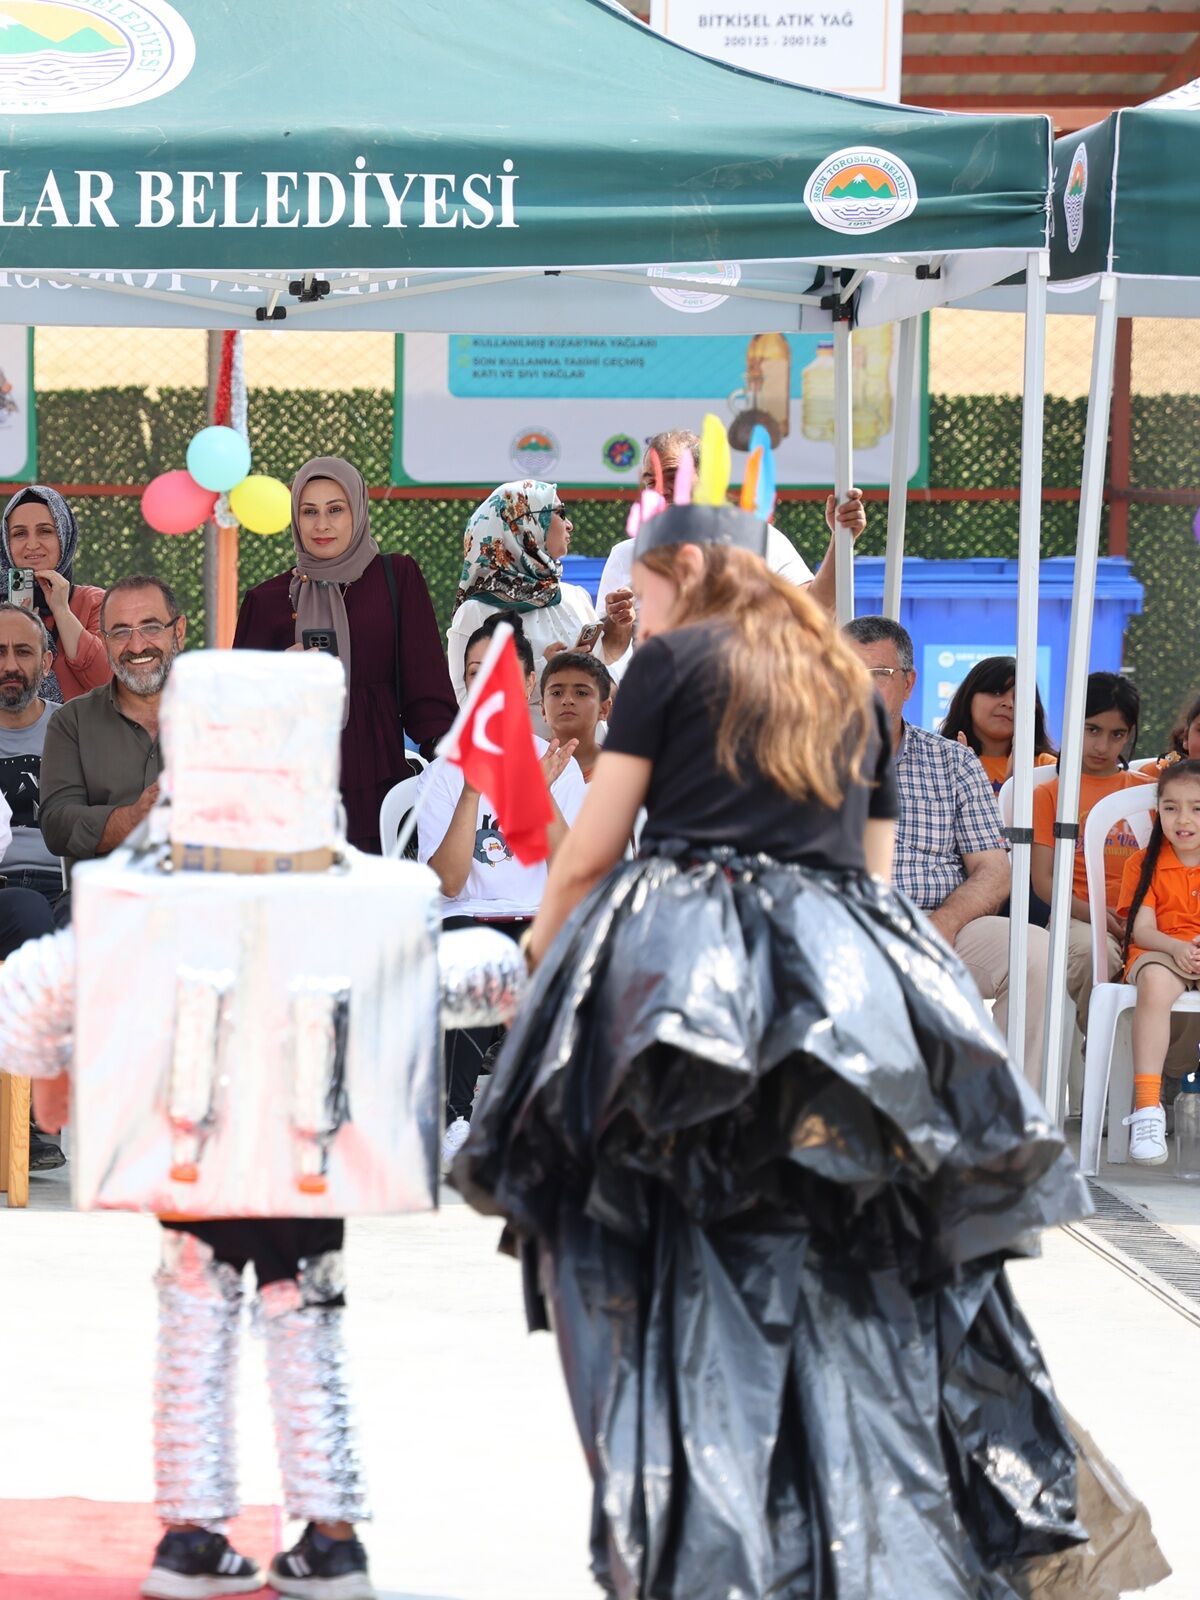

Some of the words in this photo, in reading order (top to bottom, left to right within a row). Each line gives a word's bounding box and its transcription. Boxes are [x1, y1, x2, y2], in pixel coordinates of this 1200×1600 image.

[698, 12, 770, 28] BİTKİSEL
[775, 14, 815, 27] ATIK
[821, 11, 854, 27] YAĞ
[827, 155, 881, 175] TOROSLAR
[135, 155, 520, 229] BELEDİYESİ
